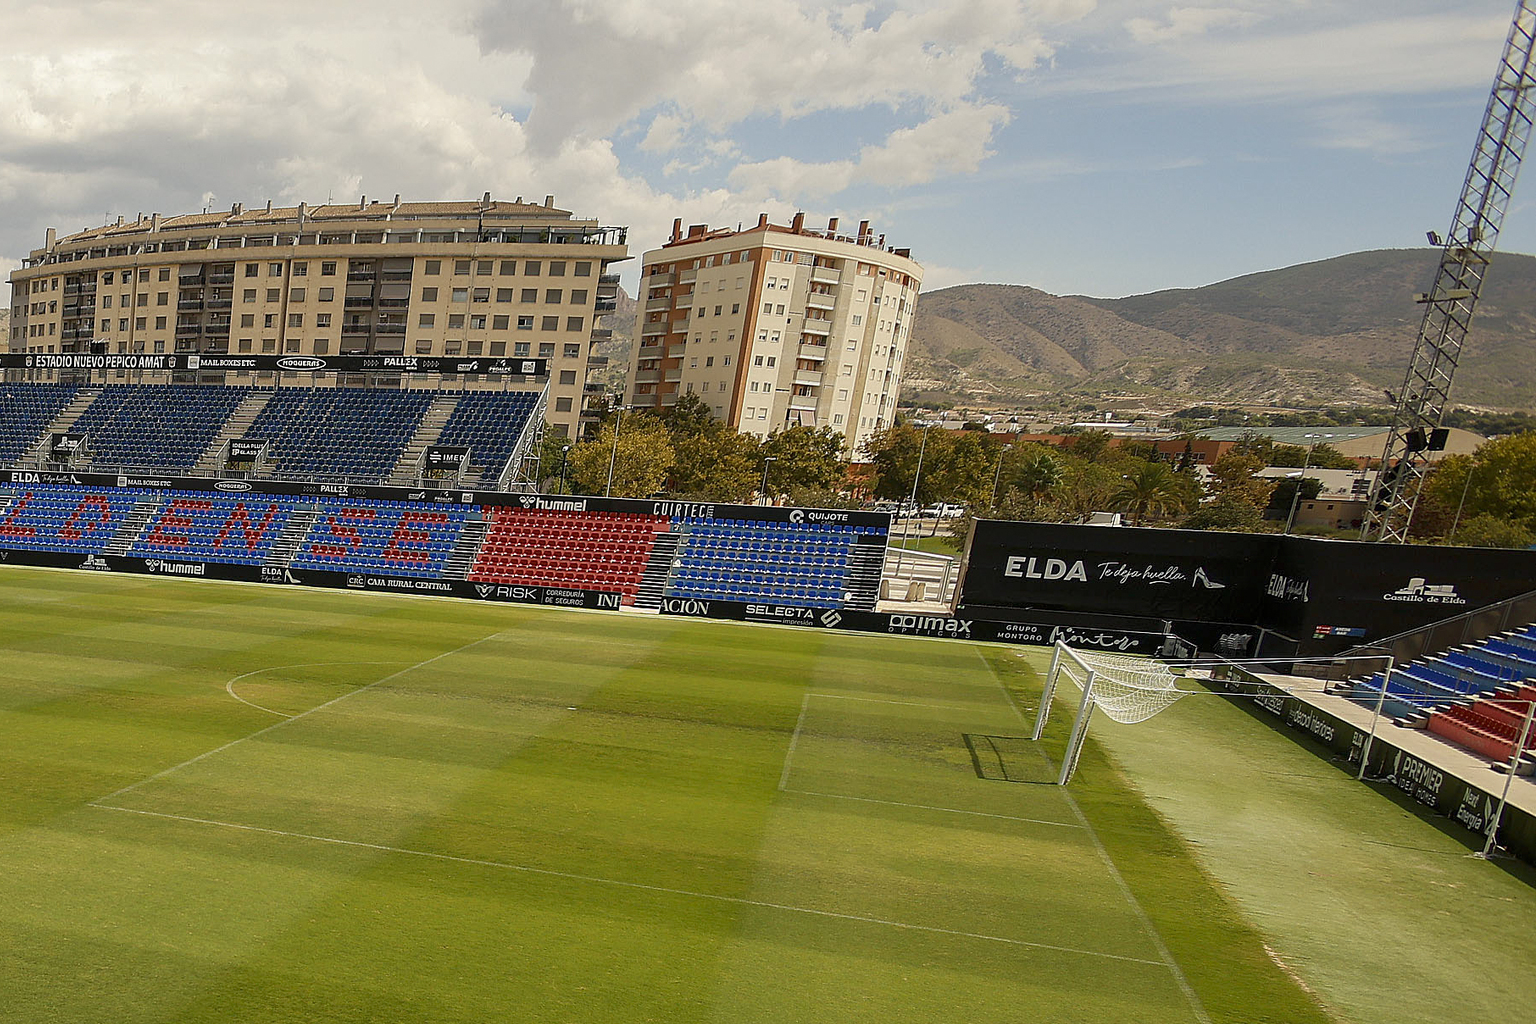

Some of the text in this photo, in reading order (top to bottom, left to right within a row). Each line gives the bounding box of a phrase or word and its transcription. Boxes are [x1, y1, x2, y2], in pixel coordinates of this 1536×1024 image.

[36, 356, 164, 368] ESTADIO NUEVO PEPICO AMAT
[384, 357, 418, 366] PALLEX
[12, 472, 40, 483] ELDA
[320, 485, 348, 493] PALLEX
[536, 497, 587, 511] hummel
[653, 502, 705, 518] CUIRTEC
[808, 512, 849, 521] QUIJOTE
[160, 559, 205, 575] hummel
[261, 567, 282, 576] ELDA
[1004, 556, 1087, 581] ELDA
[387, 580, 414, 588] RURAL
[415, 582, 452, 590] CENTRAL
[497, 586, 537, 599] RISK
[546, 589, 584, 598] CORREDURÍA
[1383, 593, 1423, 602] Castillo
[555, 597, 584, 606] SEGUROS
[745, 604, 814, 619] SELECTA
[782, 618, 814, 626] impresión
[1006, 624, 1037, 632] GRUPO
[997, 632, 1042, 641] MONTORO
[1402, 756, 1443, 793] PREMIER
[1415, 788, 1436, 806] HOMES
[1463, 787, 1479, 808] Next
[1456, 803, 1482, 829] Energía
